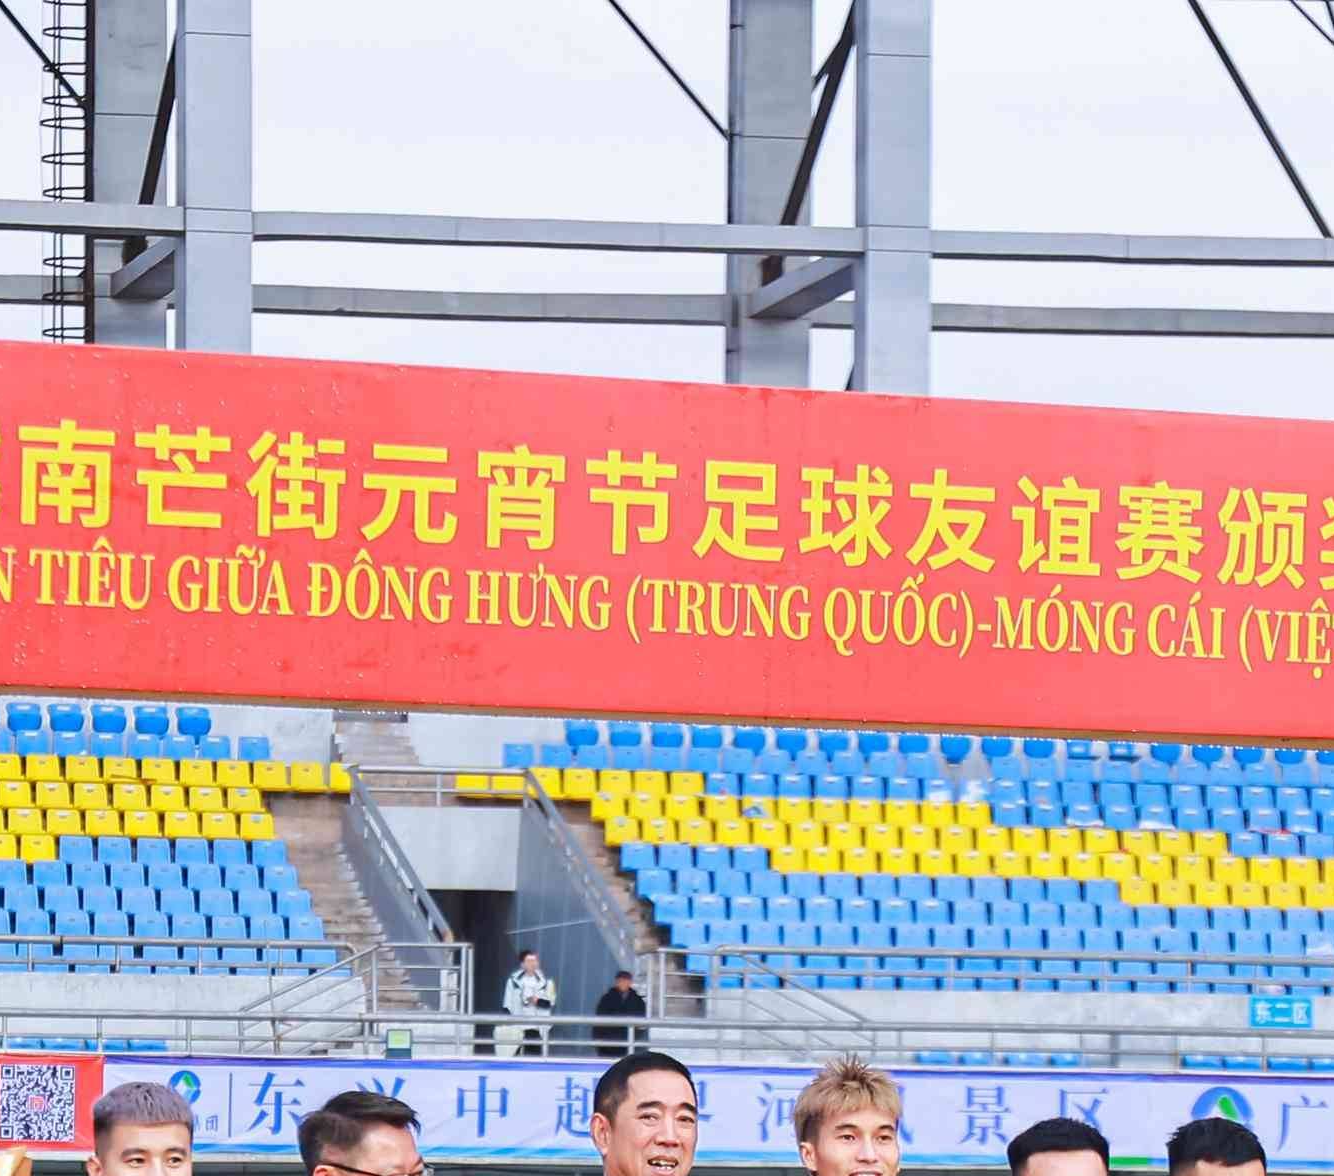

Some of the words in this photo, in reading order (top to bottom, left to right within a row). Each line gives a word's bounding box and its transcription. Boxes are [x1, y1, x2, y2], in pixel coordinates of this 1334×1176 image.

[29, 537, 156, 610] TIÊU
[167, 544, 291, 616] GIỮA
[306, 548, 453, 624] ĐÔNG
[464, 563, 613, 631] HƯNG
[626, 574, 812, 642] (TRUNG
[1147, 590, 1226, 660] CÁI
[1255, 999, 1310, 1025] 东二区
